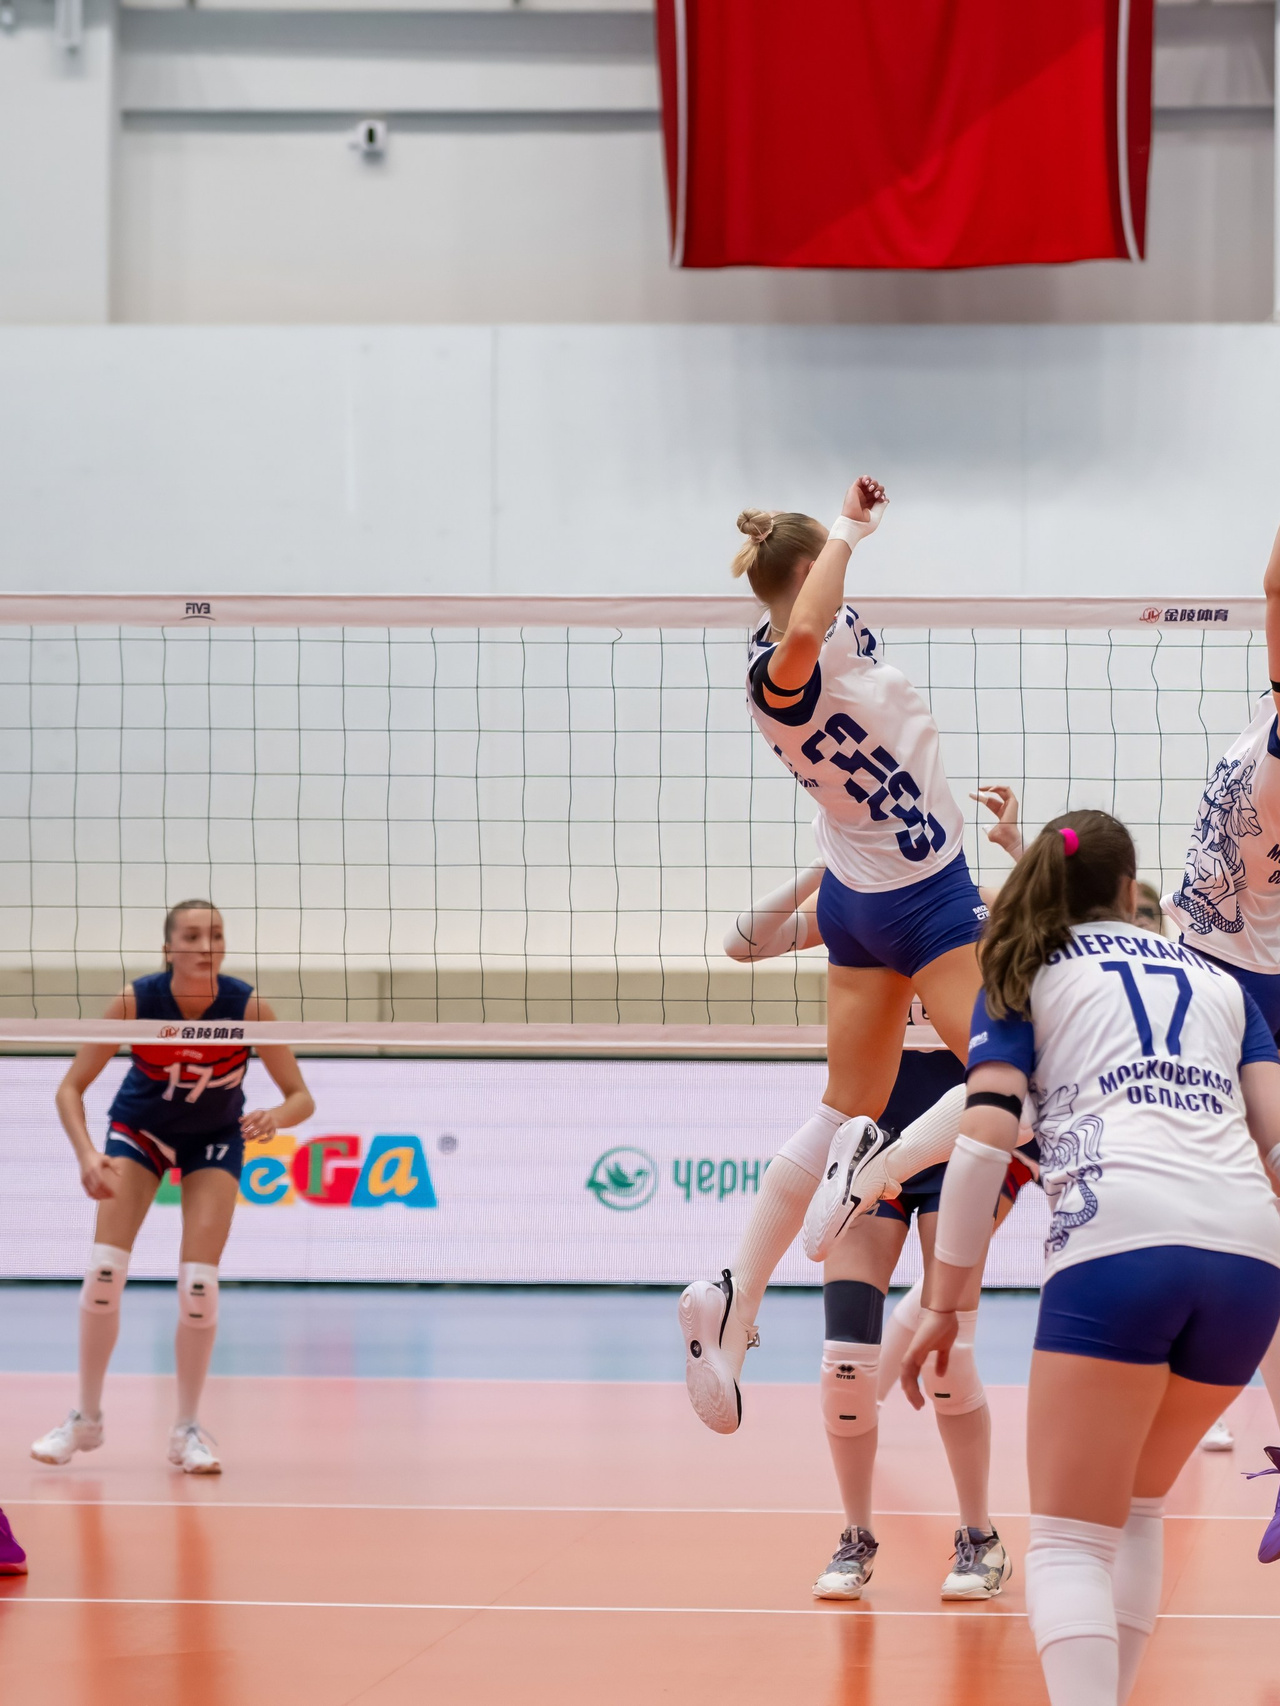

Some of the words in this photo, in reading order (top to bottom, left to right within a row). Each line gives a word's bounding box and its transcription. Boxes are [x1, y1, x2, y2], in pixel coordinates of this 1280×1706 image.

[1164, 608, 1229, 622] 金陵体育
[1099, 961, 1193, 1057] 17
[181, 1027, 244, 1040] 金陵体育
[163, 1063, 213, 1103] 17
[1098, 1060, 1233, 1100] МОСКОВСКАЯ
[1127, 1085, 1223, 1115] ОБЛАСТЬ
[206, 1144, 229, 1160] 17
[673, 1158, 773, 1202] черн
